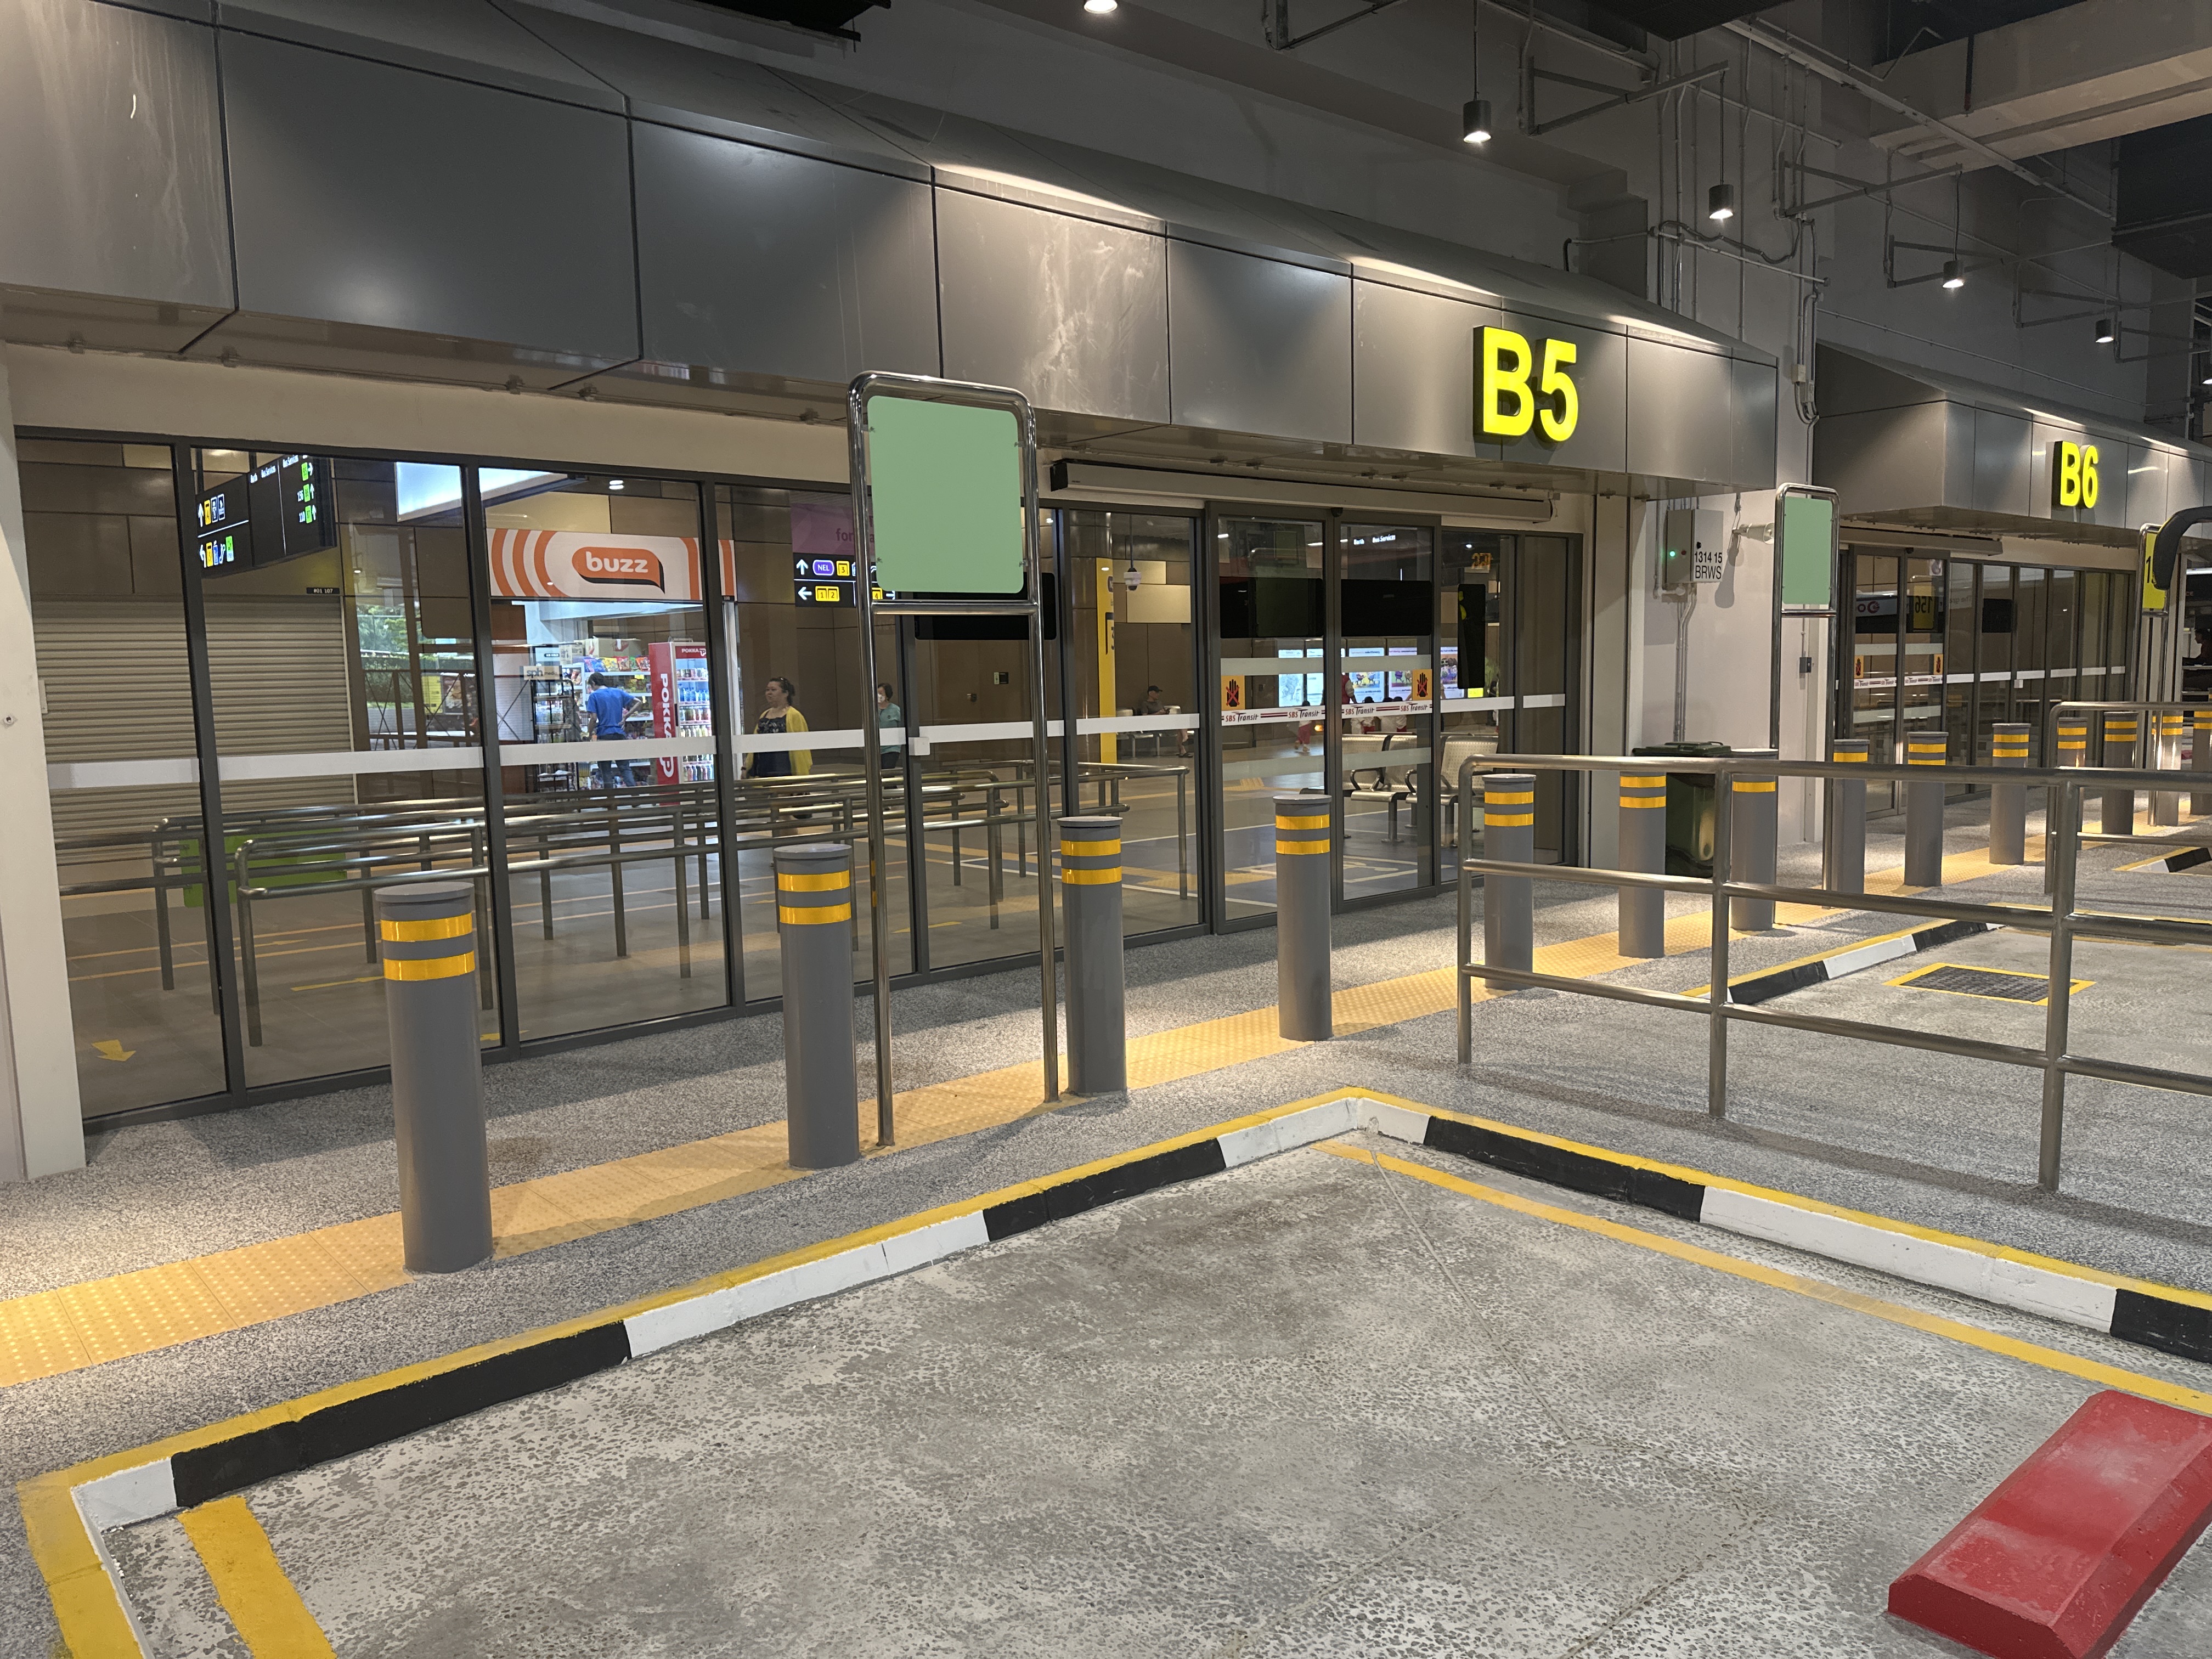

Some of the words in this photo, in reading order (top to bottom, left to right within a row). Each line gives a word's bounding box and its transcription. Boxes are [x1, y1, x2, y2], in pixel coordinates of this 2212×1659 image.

[1482, 326, 1578, 441] B5
[2060, 441, 2098, 509] B6
[585, 551, 648, 573] buzz
[1695, 551, 1712, 563] 1314
[1714, 552, 1723, 563] 15
[1695, 565, 1722, 579] BRWS
[527, 667, 543, 679] sph
[1354, 706, 1374, 715] Transit
[1409, 703, 1428, 712] Transit
[1235, 713, 1259, 723] Transit
[1297, 709, 1319, 719] Transit
